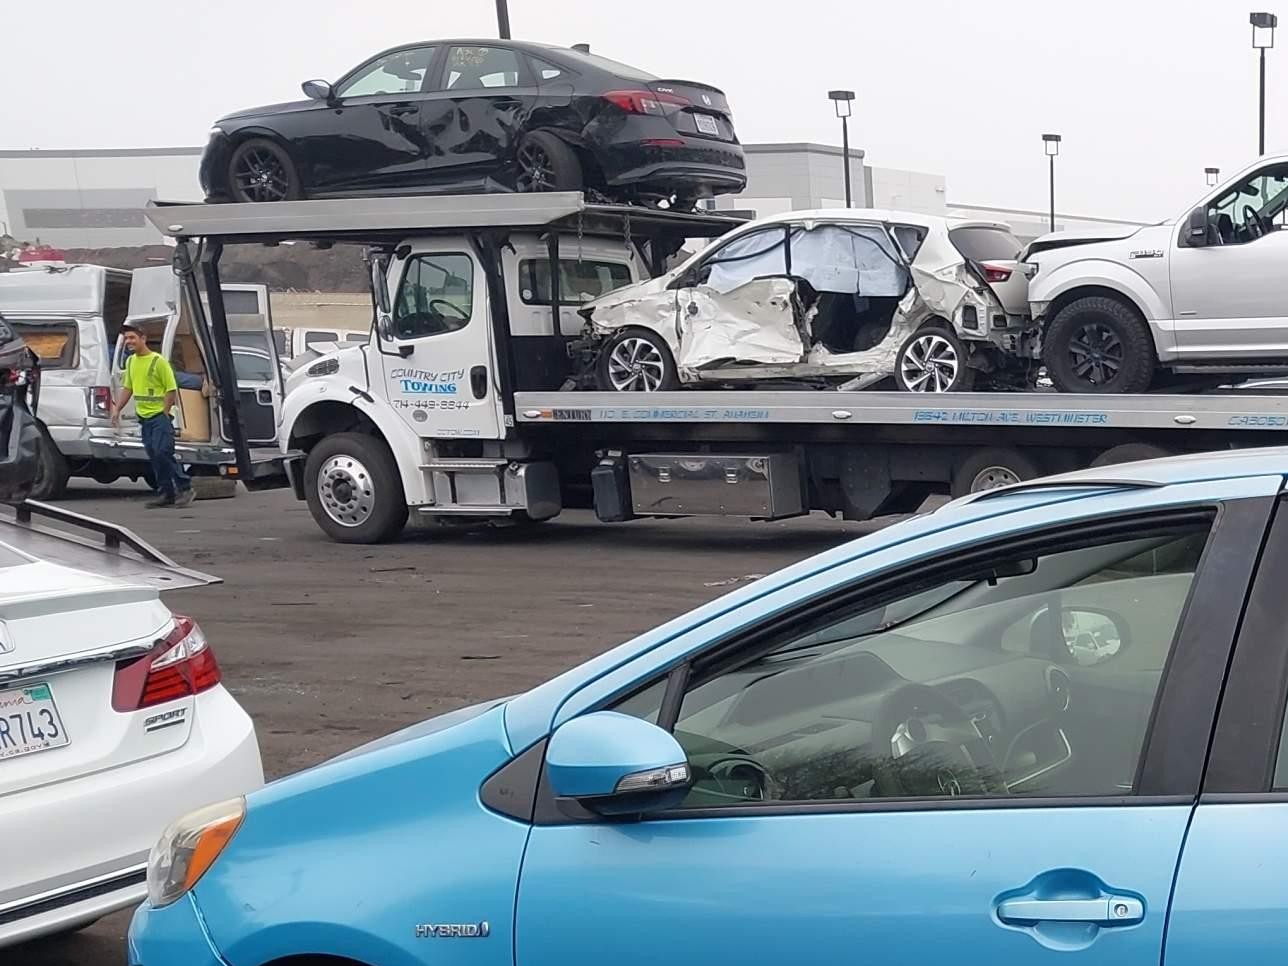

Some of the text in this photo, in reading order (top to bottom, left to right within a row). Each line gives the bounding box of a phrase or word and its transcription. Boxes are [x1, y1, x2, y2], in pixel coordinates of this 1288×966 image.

[391, 368, 465, 382] COUNTRY CITY
[400, 379, 457, 392] TOWING
[1026, 413, 1107, 424] WESTMINSTER
[144, 706, 188, 727] SPORT
[0, 708, 59, 750] R743
[416, 923, 480, 938] HYBRID
